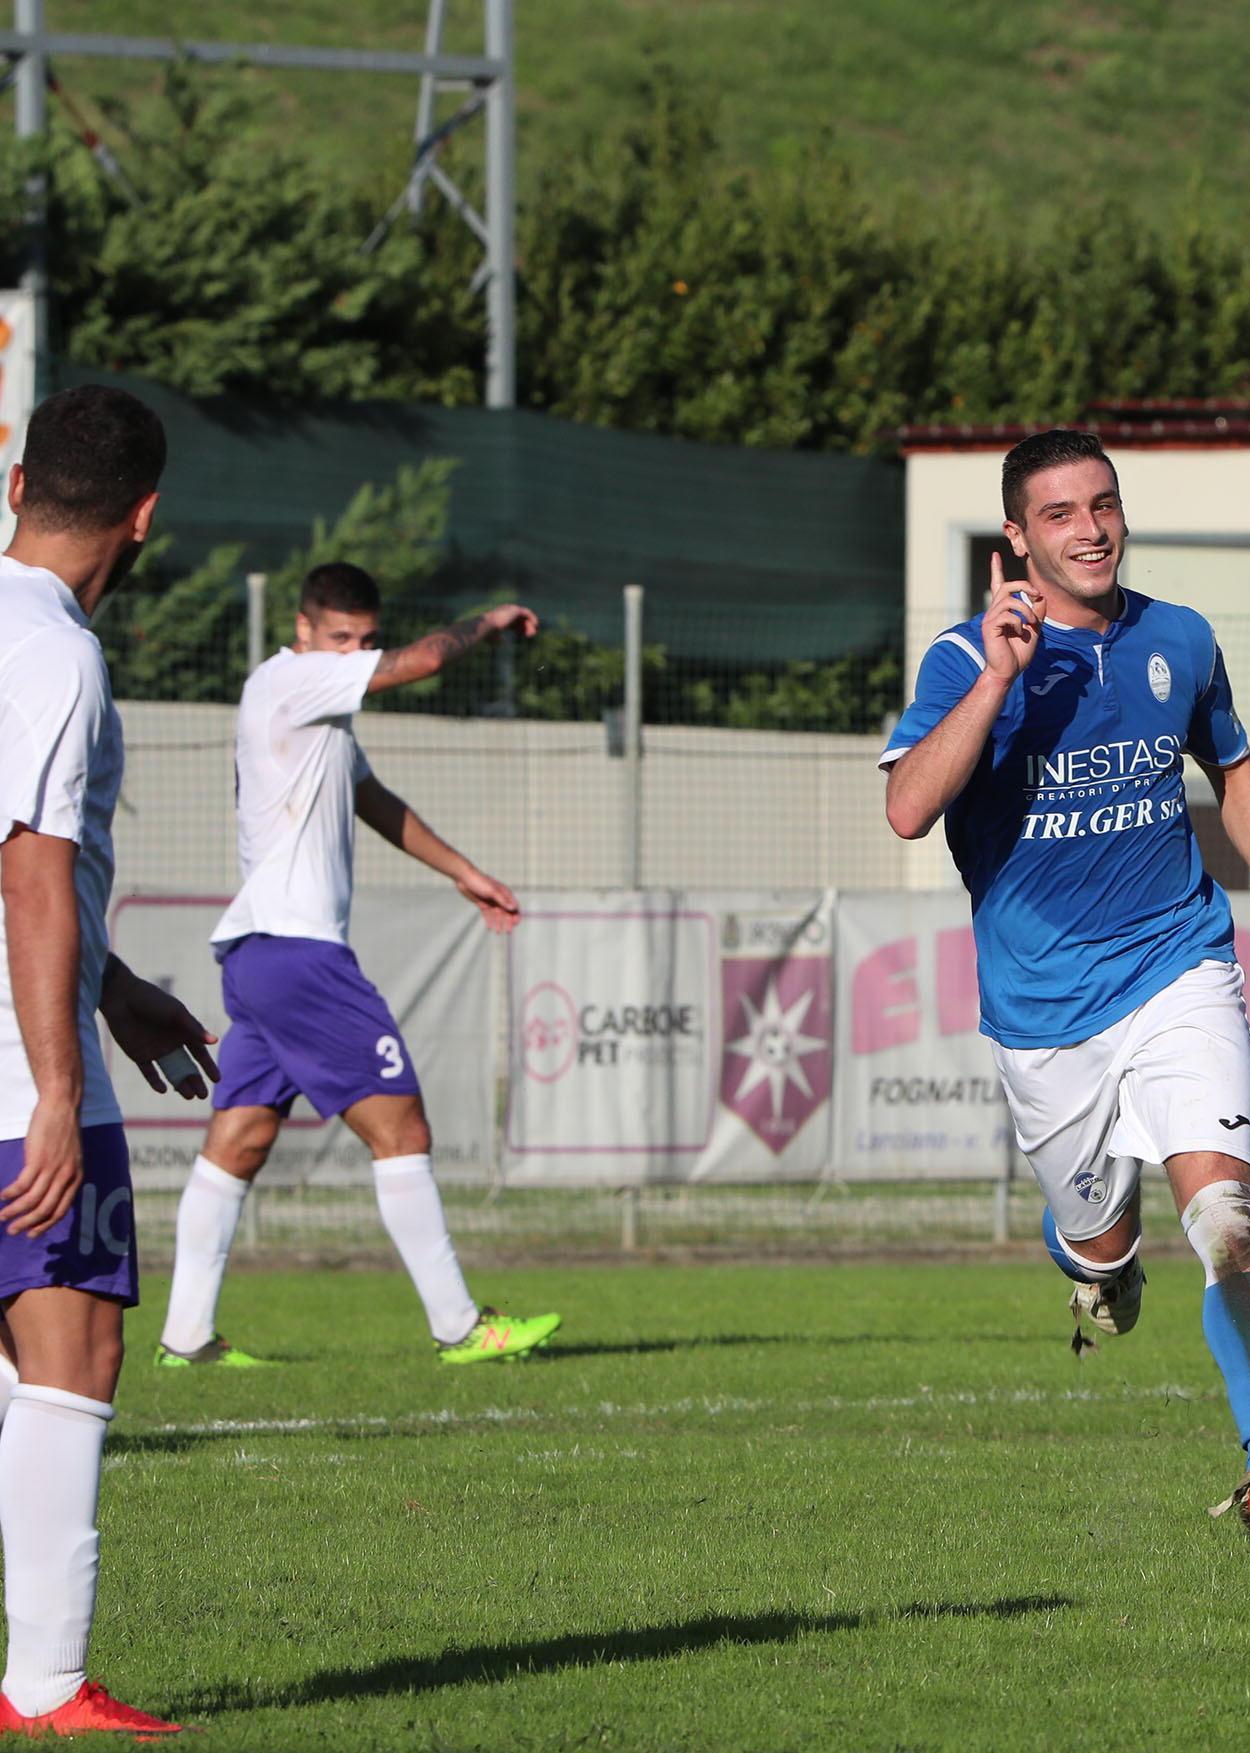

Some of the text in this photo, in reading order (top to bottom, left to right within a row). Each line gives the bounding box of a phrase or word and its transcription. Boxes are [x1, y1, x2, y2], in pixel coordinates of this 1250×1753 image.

[1026, 734, 1181, 787] INESTAS
[1025, 787, 1103, 802] CREATORI
[1020, 798, 1155, 840] TRI.GER
[375, 1034, 404, 1079] 3
[870, 1077, 1004, 1105] FOGNATU
